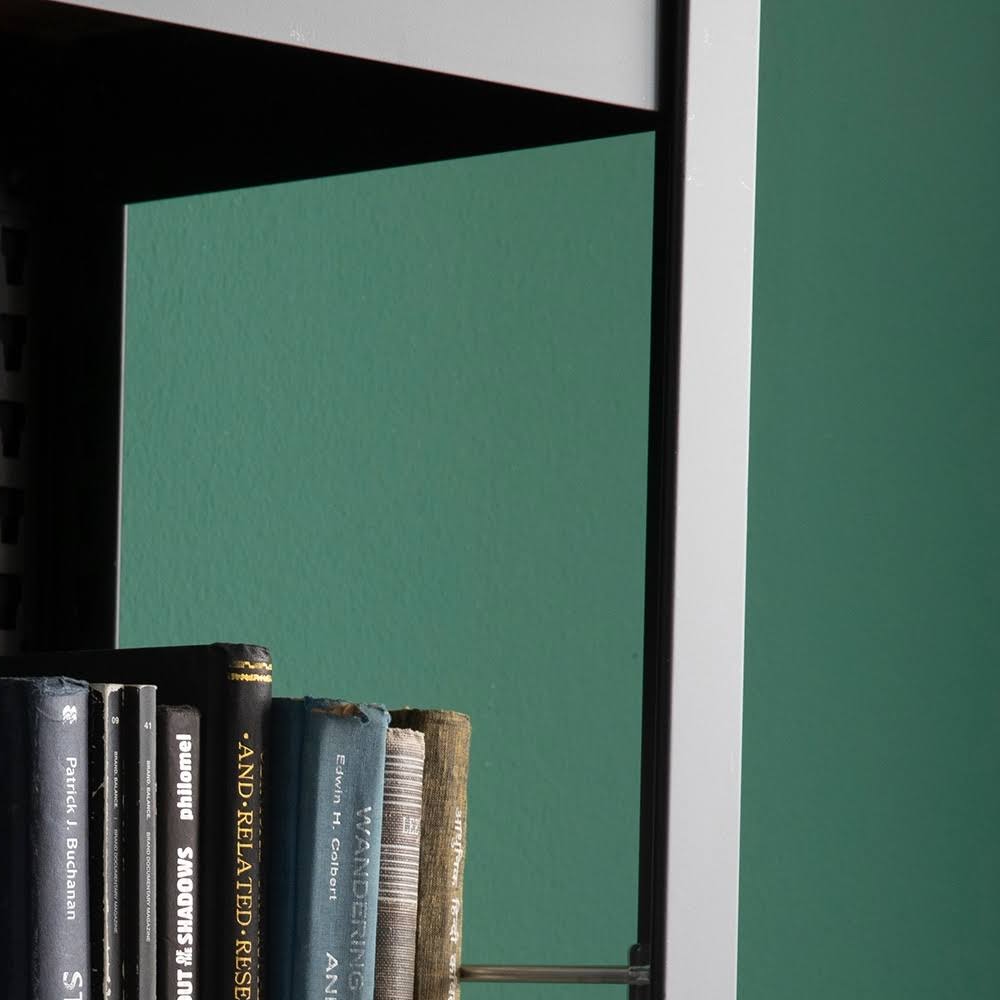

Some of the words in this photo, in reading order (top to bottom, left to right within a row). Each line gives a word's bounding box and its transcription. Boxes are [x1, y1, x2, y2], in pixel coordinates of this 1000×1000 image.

[111, 716, 119, 724] 09
[144, 721, 152, 730] 41
[66, 756, 78, 815] Patrick
[176, 733, 193, 820] philomel
[238, 741, 255, 798] AND
[333, 753, 346, 804] Edwin
[66, 818, 77, 831] J.
[332, 811, 343, 832] H.
[66, 838, 78, 921] Buchanan
[176, 846, 194, 945] SHADOWS
[236, 808, 254, 927] RELATED
[328, 837, 341, 903] Colbert
[348, 806, 372, 992] WANDERING
[175, 949, 184, 964] OF
[184, 946, 193, 966] THE
